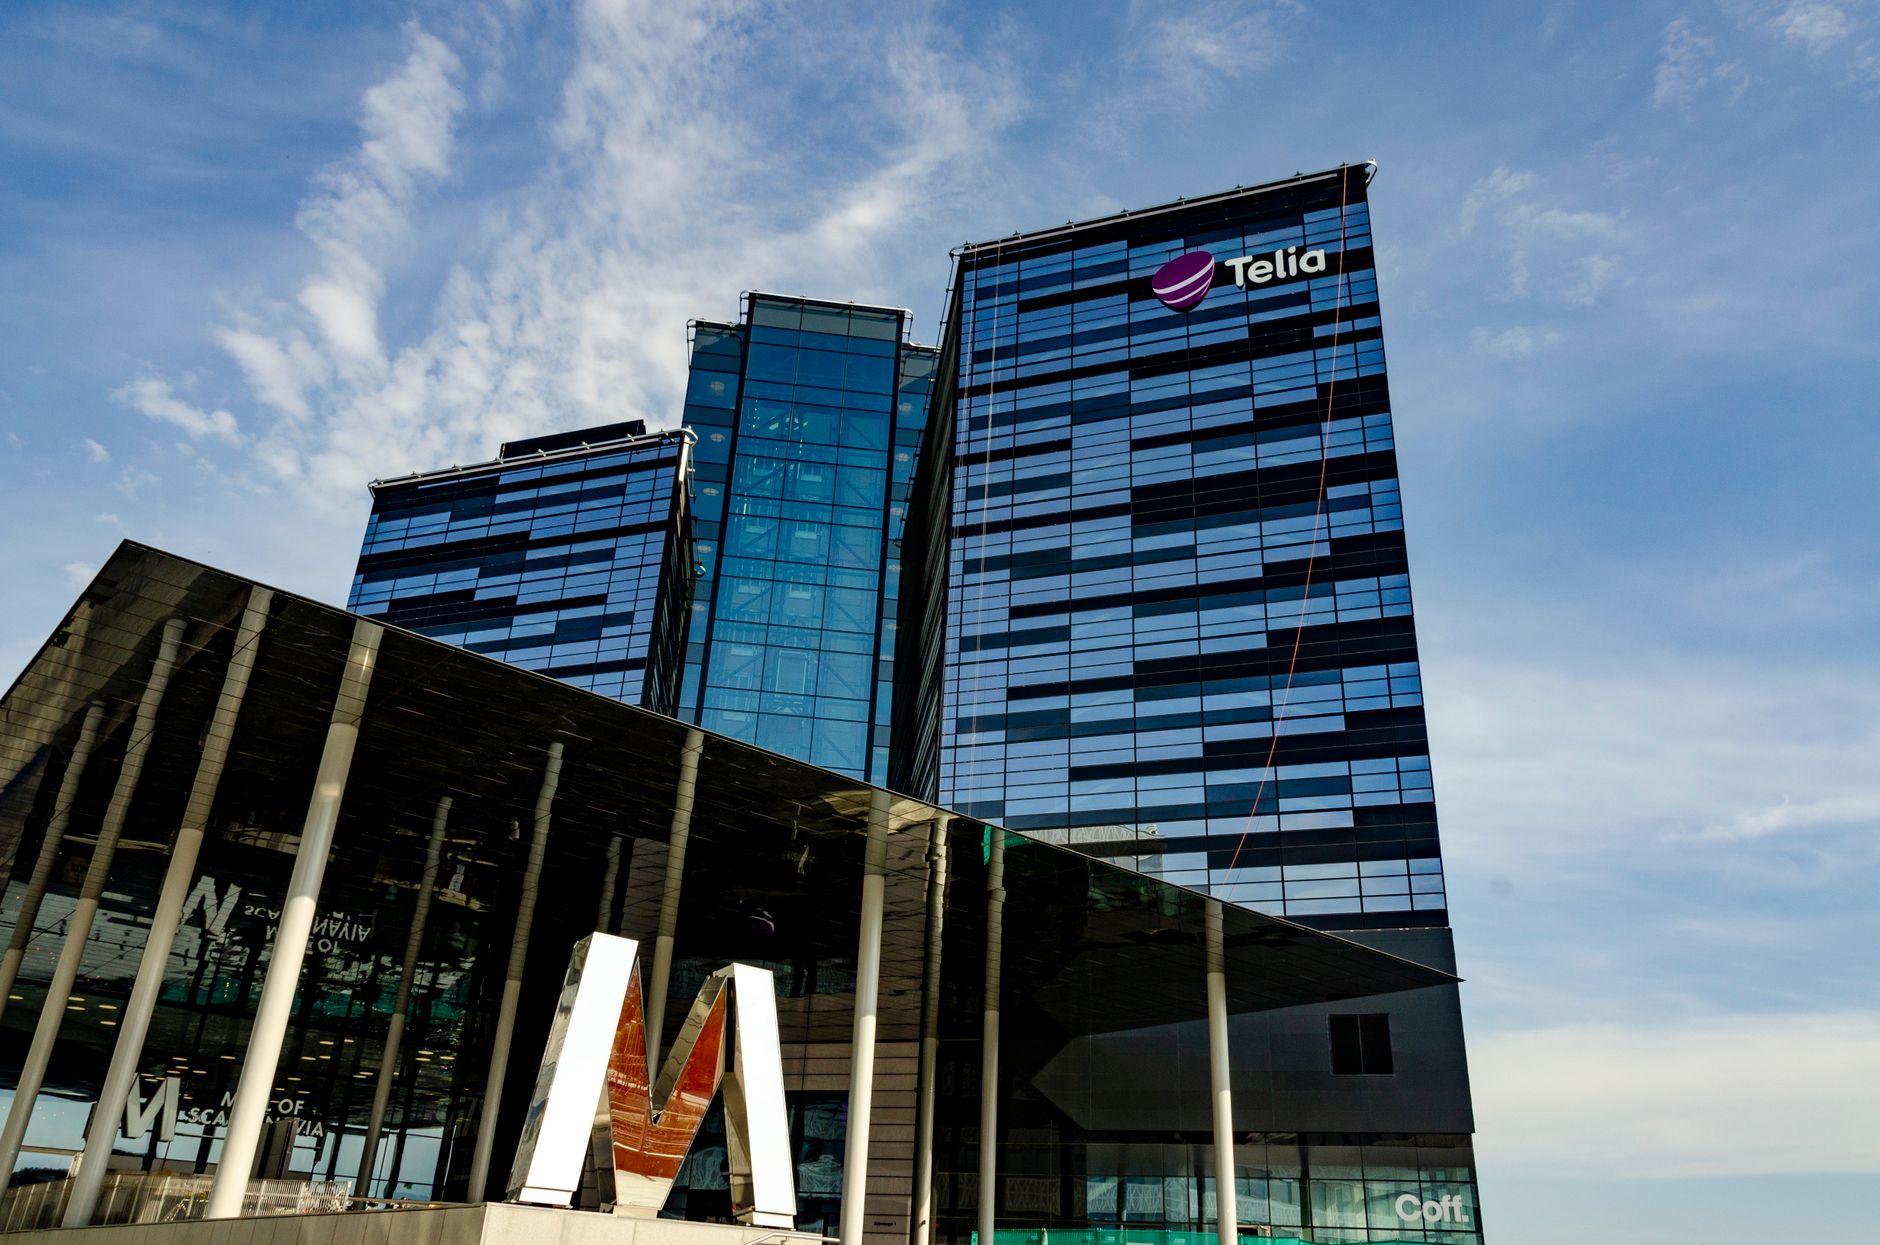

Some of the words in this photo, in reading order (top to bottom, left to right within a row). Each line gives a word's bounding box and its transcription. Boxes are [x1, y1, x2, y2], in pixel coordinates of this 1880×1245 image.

[1224, 245, 1326, 287] Telia
[508, 931, 796, 1229] M
[278, 1099, 305, 1115] OF
[1395, 1194, 1469, 1222] Coff.
